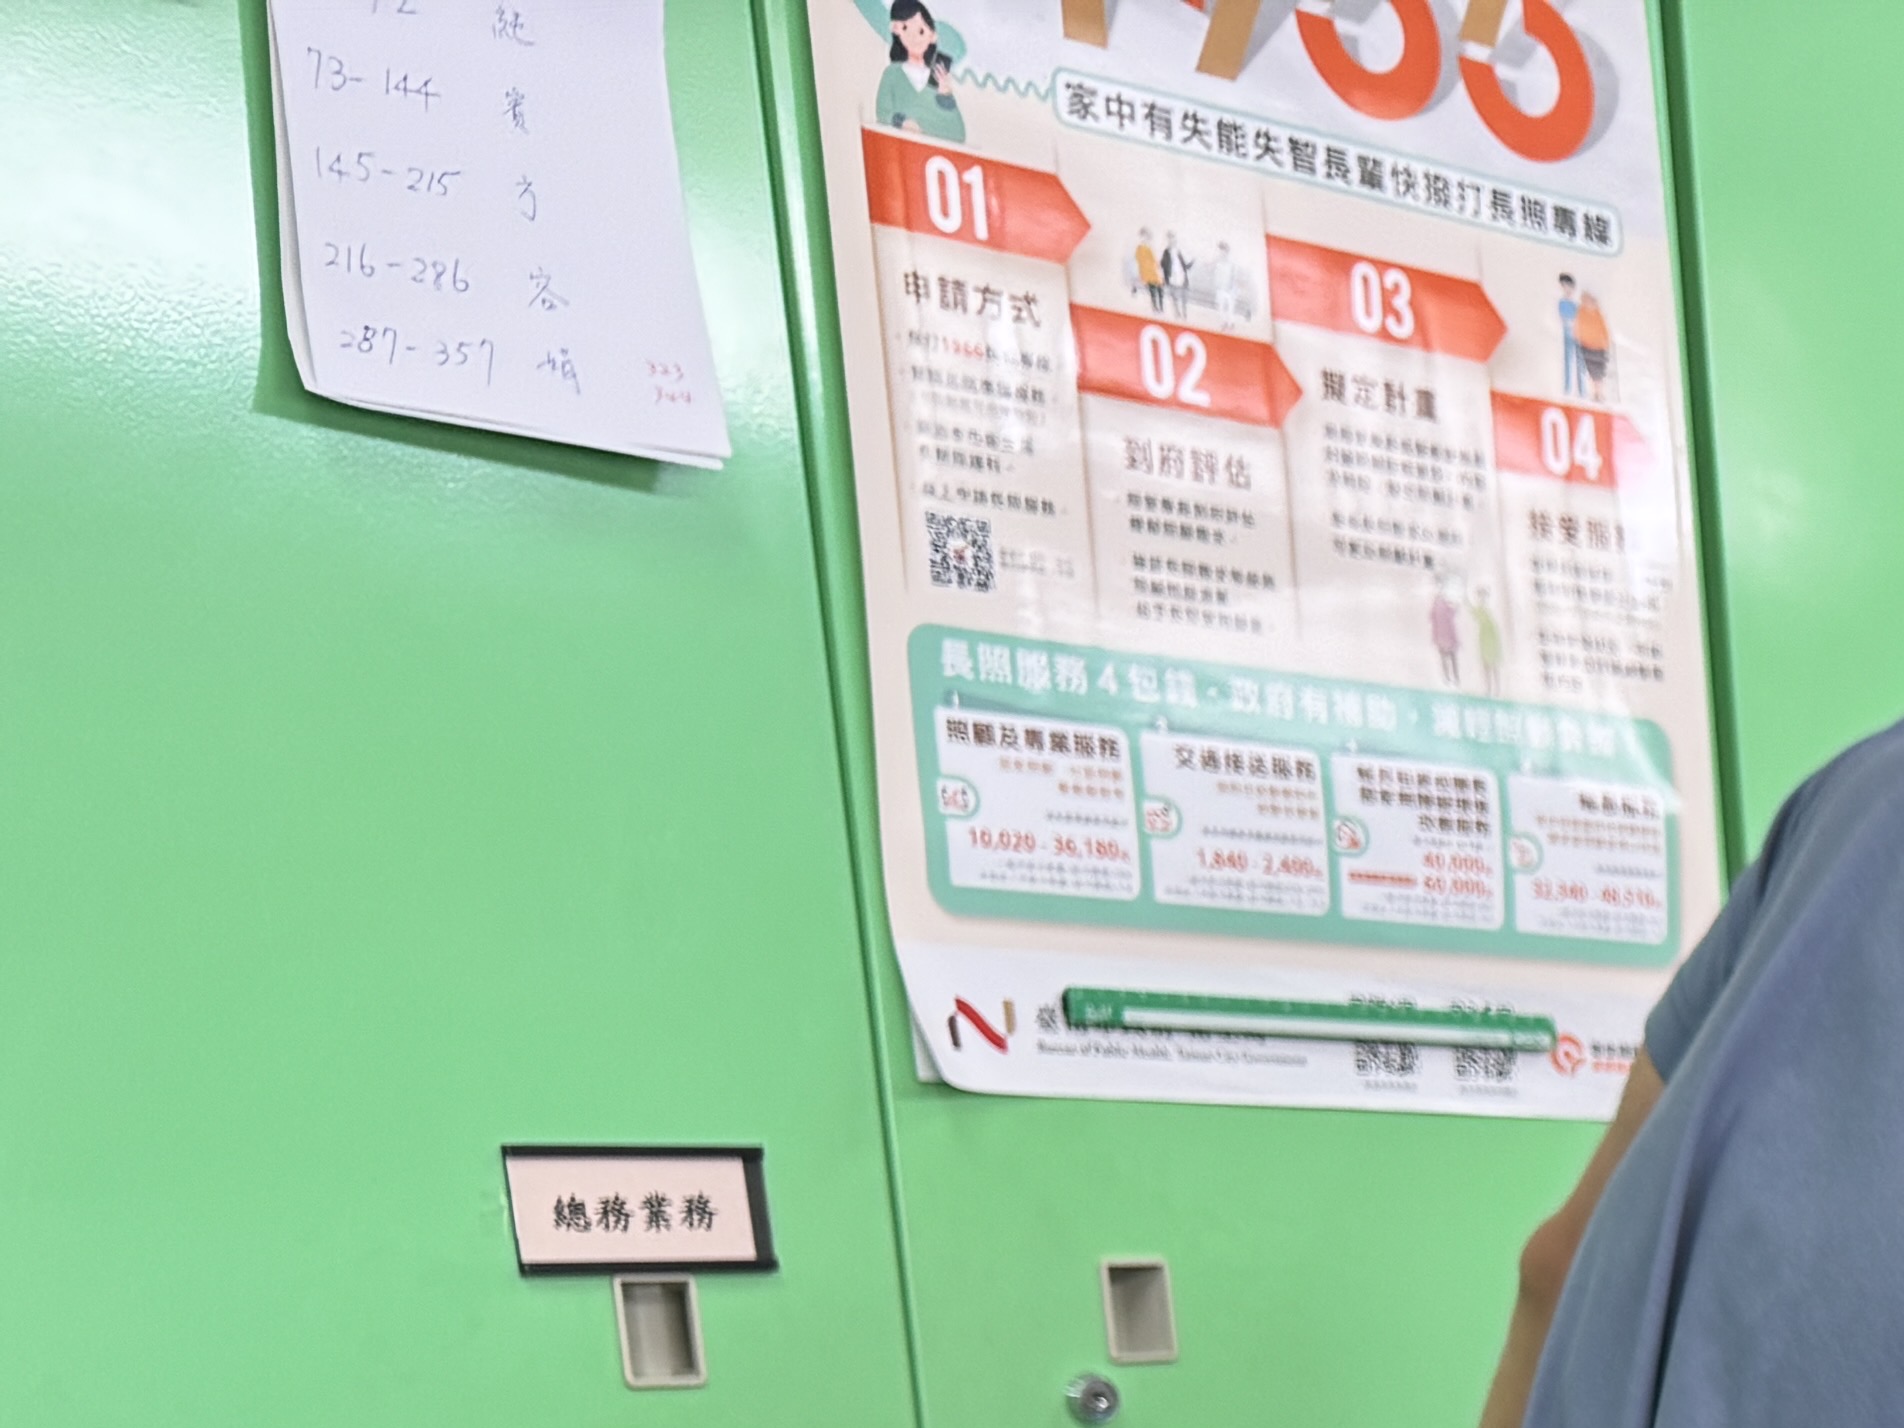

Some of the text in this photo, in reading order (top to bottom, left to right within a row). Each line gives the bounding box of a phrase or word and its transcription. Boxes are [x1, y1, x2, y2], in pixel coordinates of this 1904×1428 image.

[306, 46, 443, 113] 73-144
[314, 145, 462, 198] 145-215
[924, 155, 992, 242] 01
[323, 241, 471, 294] 216-286
[904, 268, 1042, 329] 申請方式
[1351, 261, 1416, 340] 03
[338, 323, 496, 387] 287-357
[1139, 323, 1213, 408] 02
[1122, 434, 1252, 490] 到府評估
[1540, 406, 1604, 482] 04
[552, 1189, 719, 1234] 總務業務
